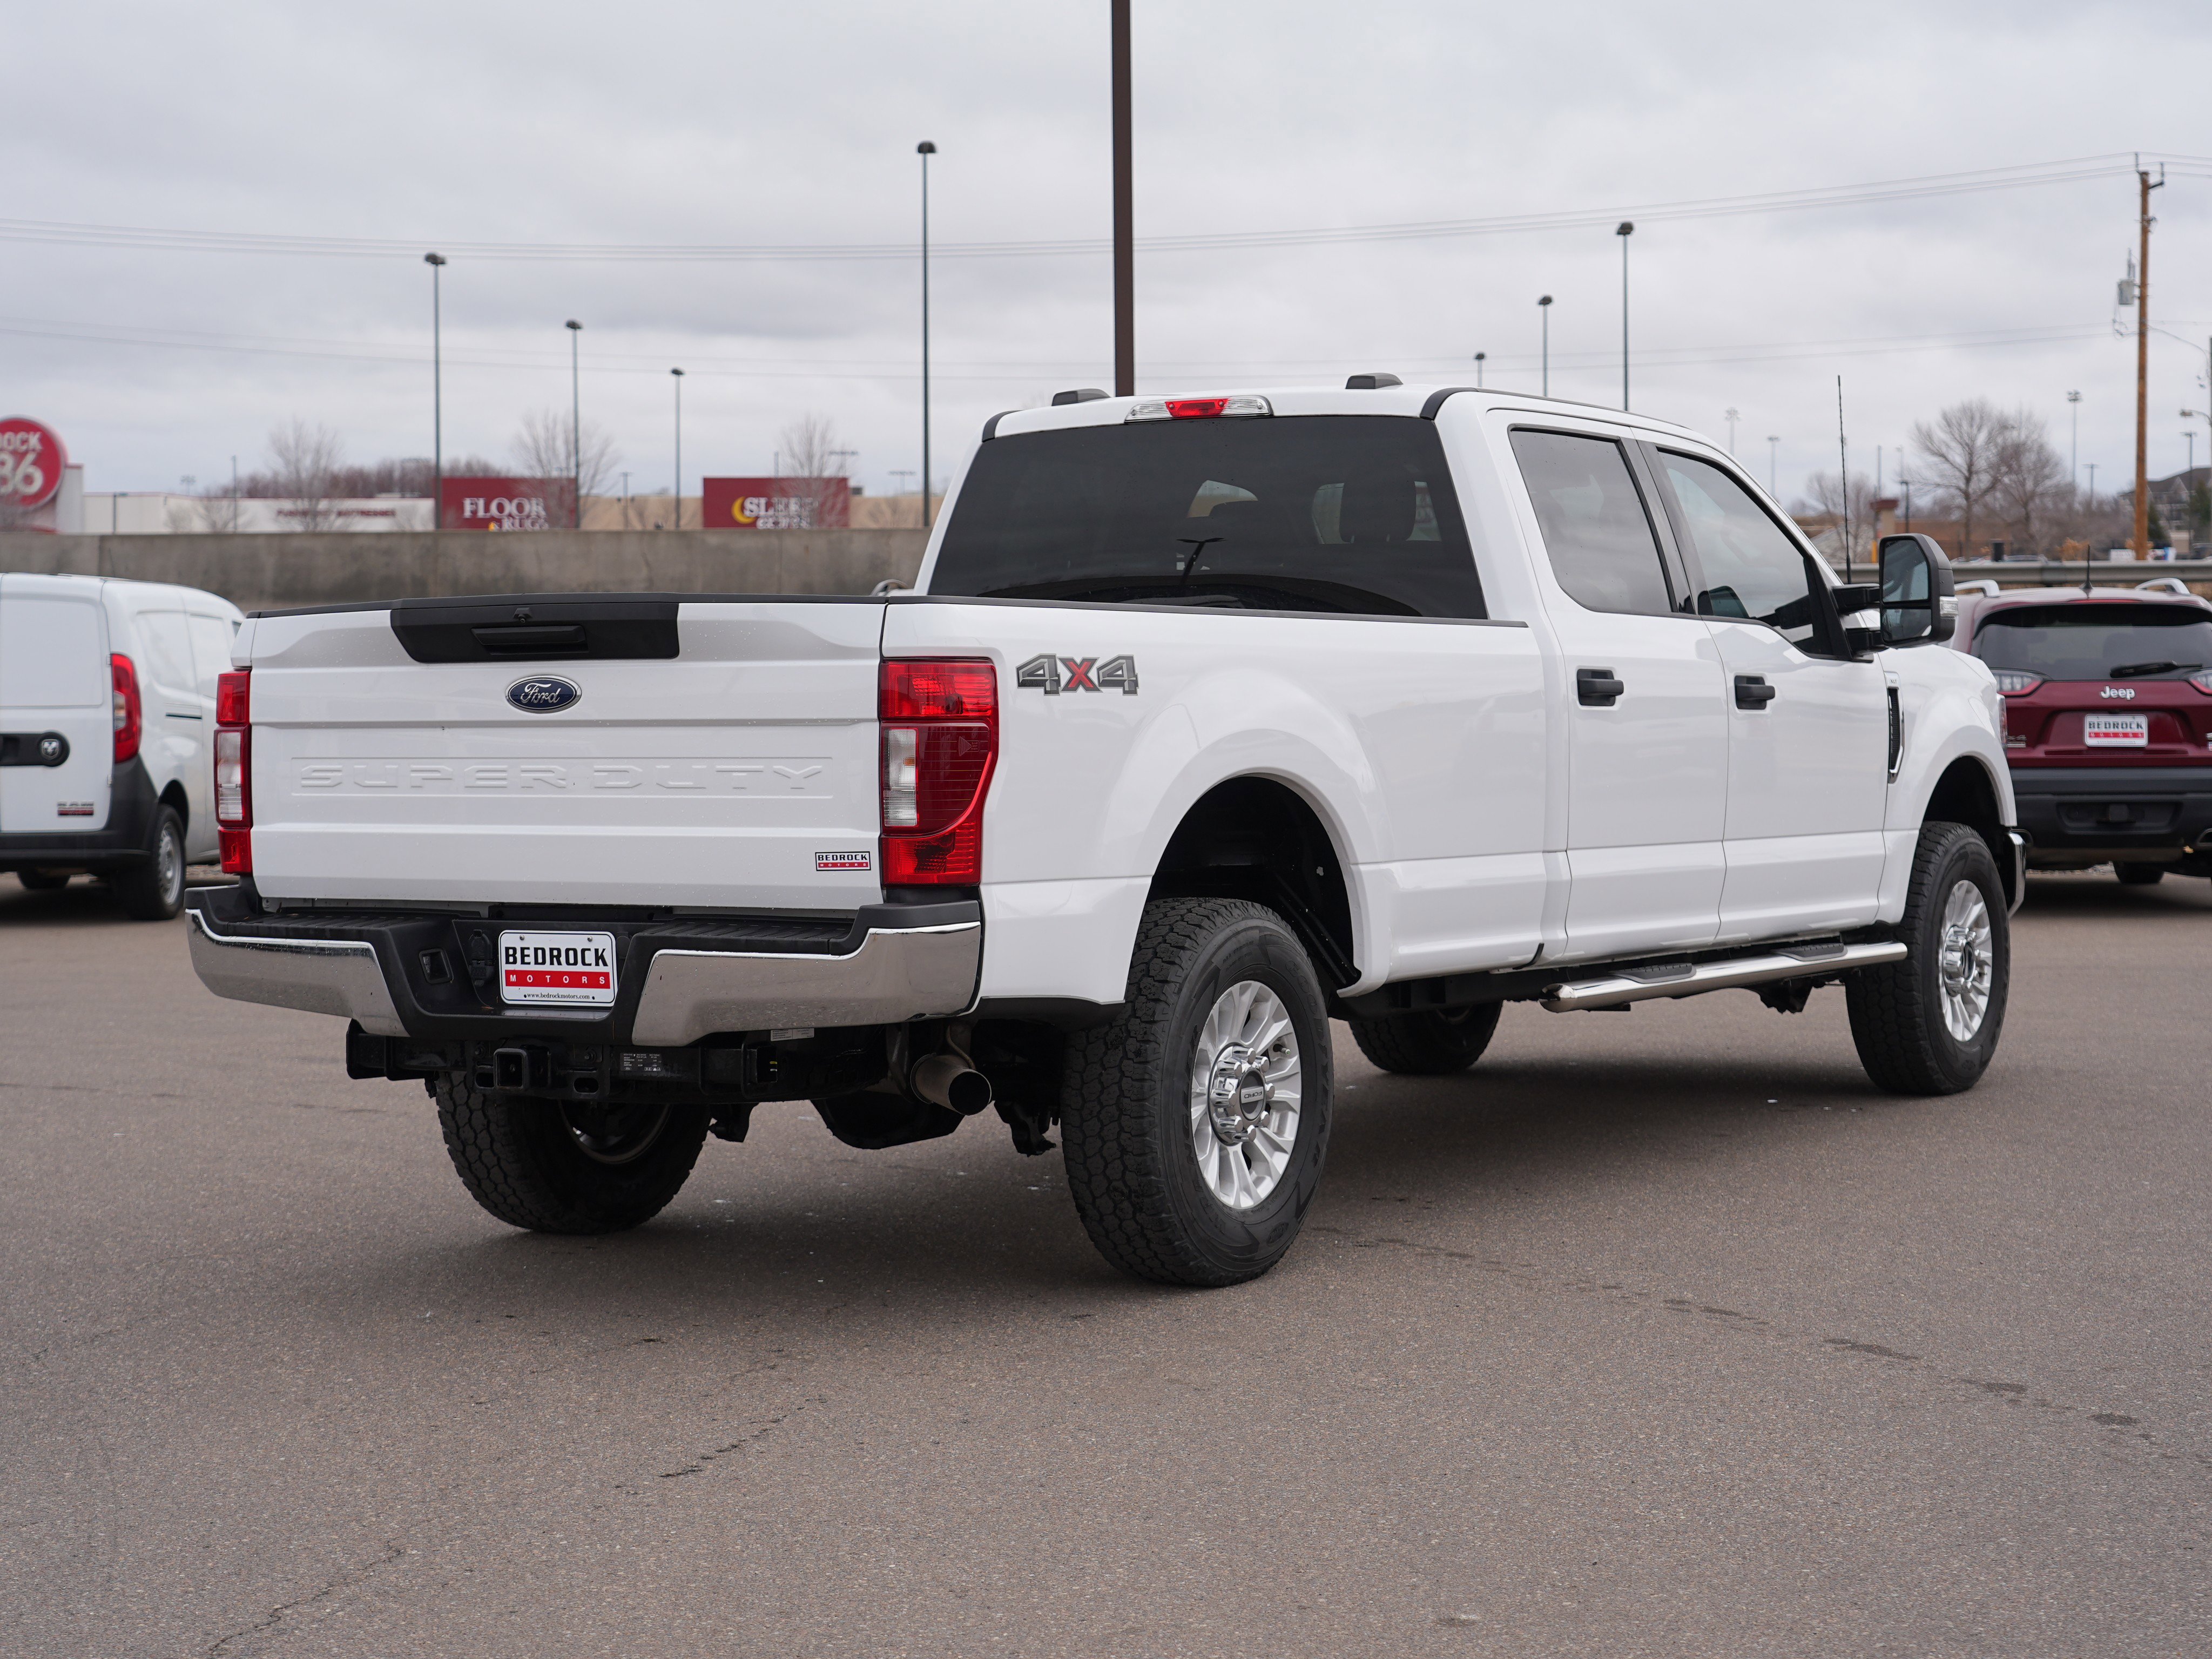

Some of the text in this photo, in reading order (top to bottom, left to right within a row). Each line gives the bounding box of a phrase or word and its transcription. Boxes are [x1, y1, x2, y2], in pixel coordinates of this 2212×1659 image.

[0, 431, 42, 453] OCK
[463, 497, 547, 518] FLOOR
[521, 683, 562, 703] Ford
[2100, 686, 2135, 700] Jeep
[2088, 721, 2143, 729] BEDROCK
[301, 765, 822, 789] SUPER DUTY
[505, 947, 609, 967] BEDROCK
[510, 974, 605, 984] MOTORS
